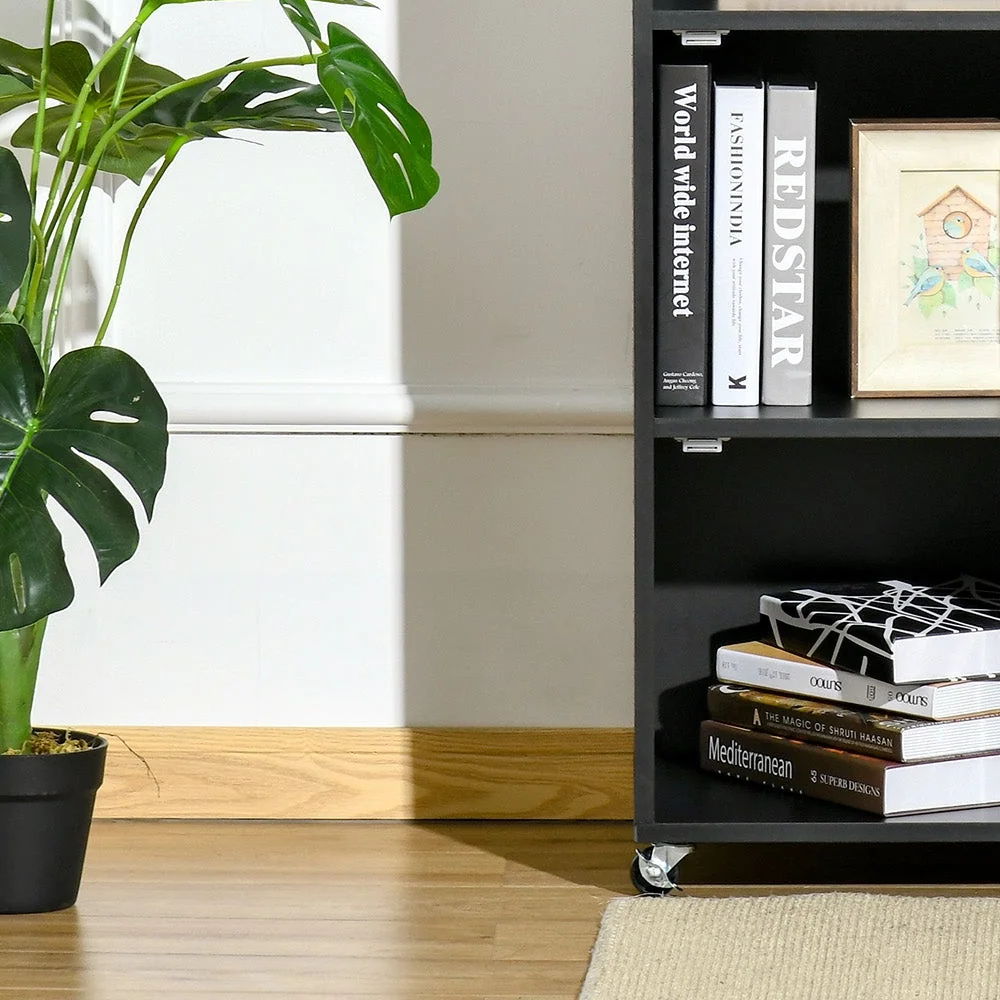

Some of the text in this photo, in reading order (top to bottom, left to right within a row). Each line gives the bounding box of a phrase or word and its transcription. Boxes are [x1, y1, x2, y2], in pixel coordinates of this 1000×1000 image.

[672, 83, 697, 318] World wide internet
[729, 112, 744, 247] FASHIONINDIA
[771, 136, 807, 368] REDSTAR
[728, 375, 747, 389] K
[765, 711, 780, 724] THE
[782, 715, 811, 730] MAGIC
[814, 722, 826, 733] OF
[829, 725, 857, 740] SHRUTI
[859, 732, 894, 748] HAASAN
[708, 735, 793, 780] Mediterranean
[819, 774, 848, 790] SUPERB
[848, 779, 881, 798] DESIGNS
